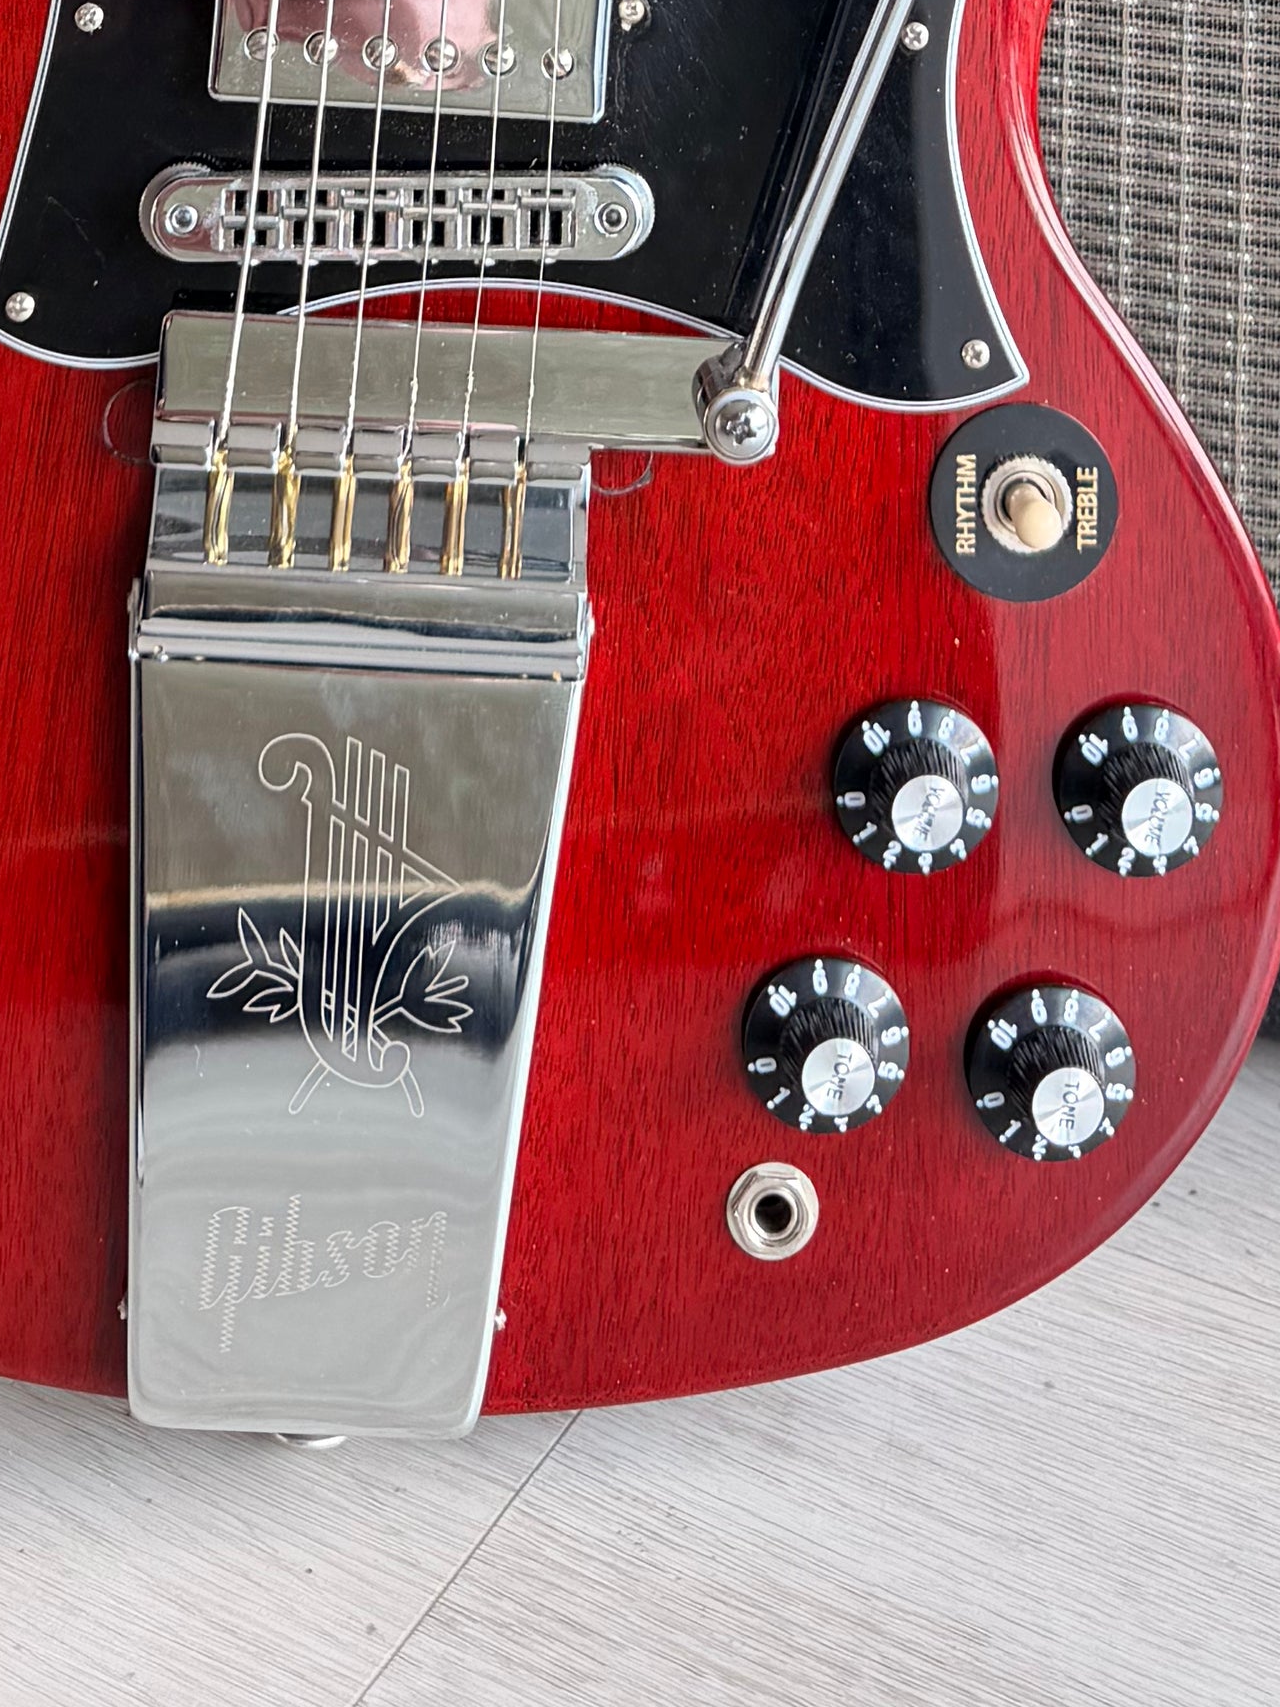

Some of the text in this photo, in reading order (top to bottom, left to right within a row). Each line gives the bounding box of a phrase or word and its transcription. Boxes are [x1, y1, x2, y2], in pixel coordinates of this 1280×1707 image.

[956, 454, 977, 555] RHYTHM
[1077, 466, 1099, 554] TREBLE
[863, 722, 891, 756] 10
[938, 716, 955, 738] 8
[1154, 716, 1169, 741] 8
[959, 742, 982, 766] 7
[1081, 733, 1108, 767] 10
[1178, 738, 1199, 761] 7
[844, 791, 866, 809] 0
[1195, 802, 1213, 822] 5
[966, 807, 986, 829] 5
[1071, 804, 1093, 823] 0
[1144, 790, 1171, 847] VOLUME
[859, 821, 877, 839] 1
[1090, 832, 1109, 851] 1
[844, 972, 861, 997] 8
[769, 984, 797, 1017] 10
[867, 995, 887, 1019] 7
[1063, 998, 1079, 1024] 8
[990, 1018, 1018, 1051] 10
[1088, 1018, 1109, 1042] 7
[755, 1057, 777, 1074] 0
[826, 1053, 853, 1101] TONE
[877, 1061, 898, 1081] 5
[773, 1086, 791, 1105] 1
[983, 1091, 1005, 1109] 0
[1105, 1082, 1126, 1101] 5
[1058, 1081, 1081, 1131] TONE
[1004, 1119, 1022, 1138] 1
[199, 1193, 450, 1353] Gibson
